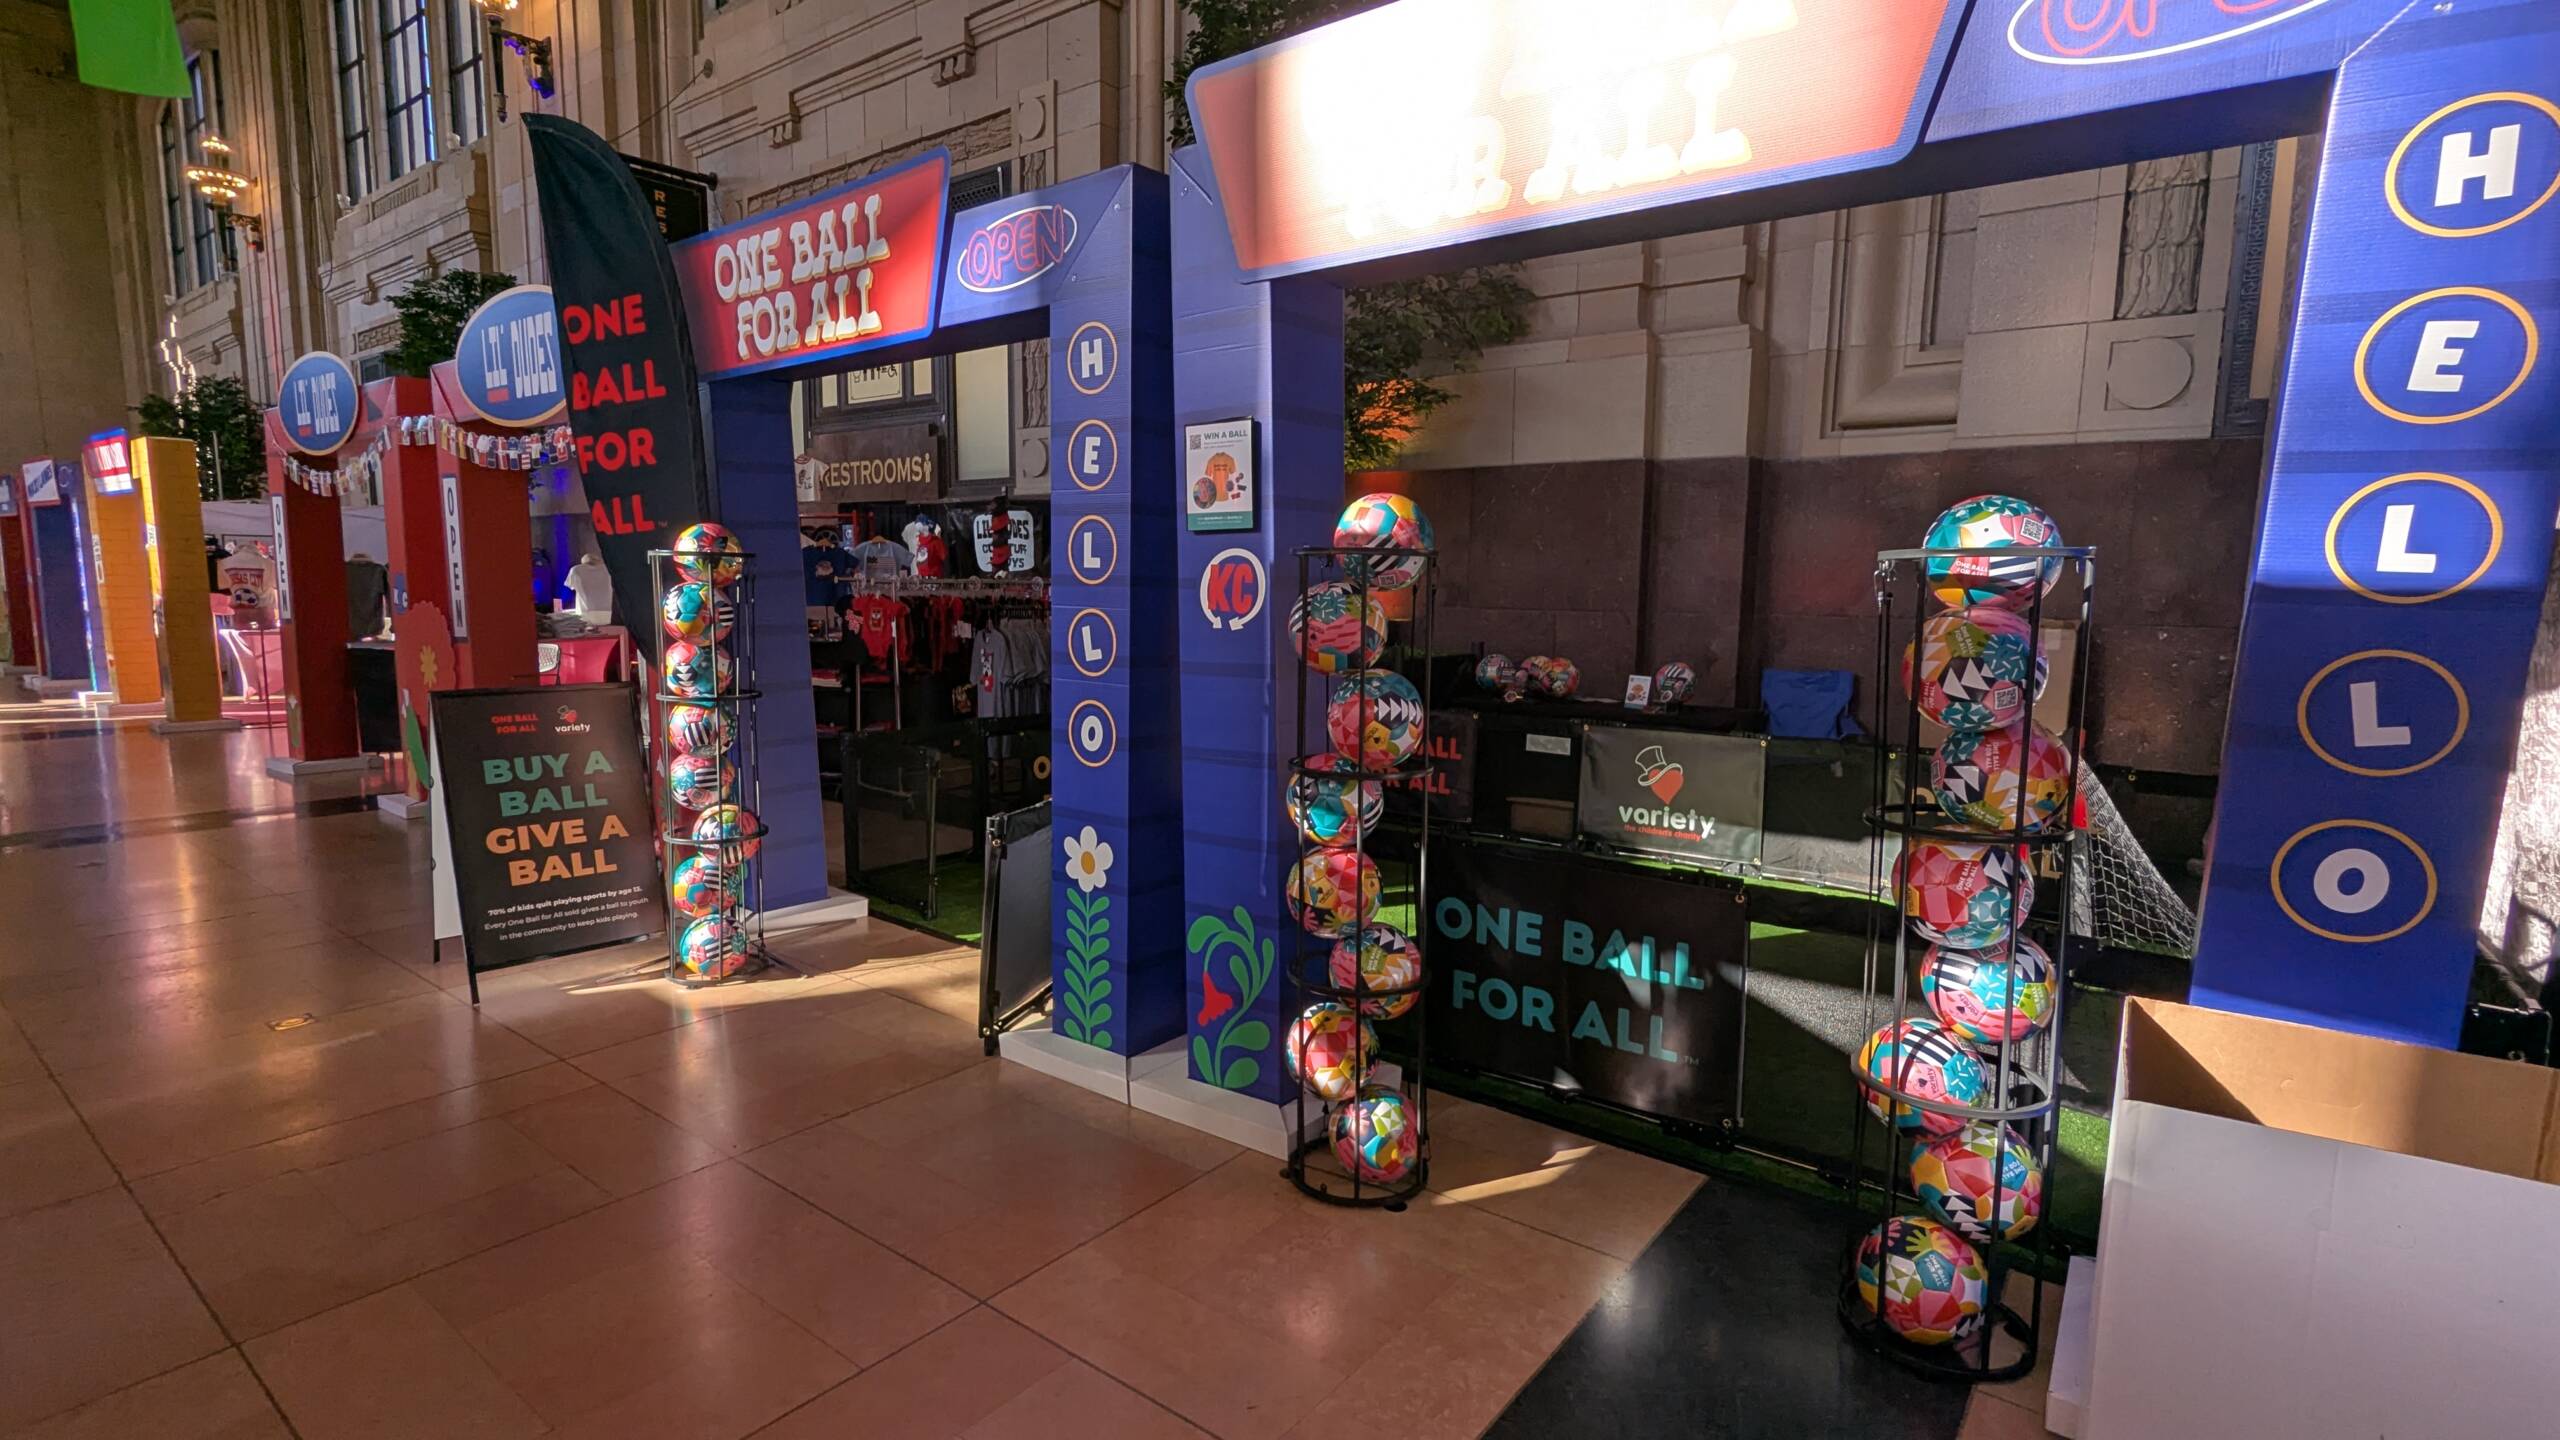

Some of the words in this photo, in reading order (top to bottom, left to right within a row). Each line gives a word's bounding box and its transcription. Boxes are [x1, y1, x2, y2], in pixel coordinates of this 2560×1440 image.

[653, 190, 668, 234] RES
[714, 227, 783, 303] ONE
[789, 193, 891, 284] BALL
[966, 203, 1065, 287] OPEN
[562, 293, 646, 345] ONE
[737, 291, 800, 360] FOR
[805, 267, 882, 347] ALL
[510, 311, 557, 399] DUDES
[311, 372, 340, 435] DUDES
[572, 359, 667, 411] BALL
[575, 428, 657, 475] FOR
[1203, 432, 1220, 440] WIN
[1221, 431, 1228, 439] A
[1228, 429, 1248, 438] BALL
[591, 494, 656, 536] ALL
[275, 503, 288, 618] OPEN
[446, 487, 463, 628] OPEN
[1208, 563, 1253, 615] KC
[491, 715, 513, 724] ONE
[515, 713, 539, 722] BALL
[496, 725, 517, 734] FOR
[519, 724, 537, 732] ALL
[554, 723, 591, 733] variety
[482, 753, 570, 785] BUY
[583, 750, 615, 775] A
[499, 783, 609, 817] BALL
[485, 818, 588, 855] GIVE
[600, 814, 630, 841] A
[1674, 831, 1701, 841] charity
[508, 848, 618, 887] BALL
[484, 921, 507, 930] Every
[507, 918, 524, 926] One
[525, 915, 540, 923] Ball
[541, 913, 552, 921] for
[564, 908, 579, 916] sold
[581, 906, 600, 914] gives
[629, 897, 649, 907] youth
[488, 908, 506, 916] 70%
[517, 903, 535, 912] kids
[535, 900, 552, 909] quit
[553, 896, 582, 907] playing
[583, 892, 607, 901] sports
[508, 931, 522, 939] the
[523, 924, 566, 936] community
[577, 919, 595, 927] keep
[596, 915, 611, 923] kids
[1436, 896, 1544, 957] ONE
[1562, 919, 1705, 991] BALL
[1452, 969, 1556, 1033] FOR
[1571, 1000, 1679, 1064] ALL
